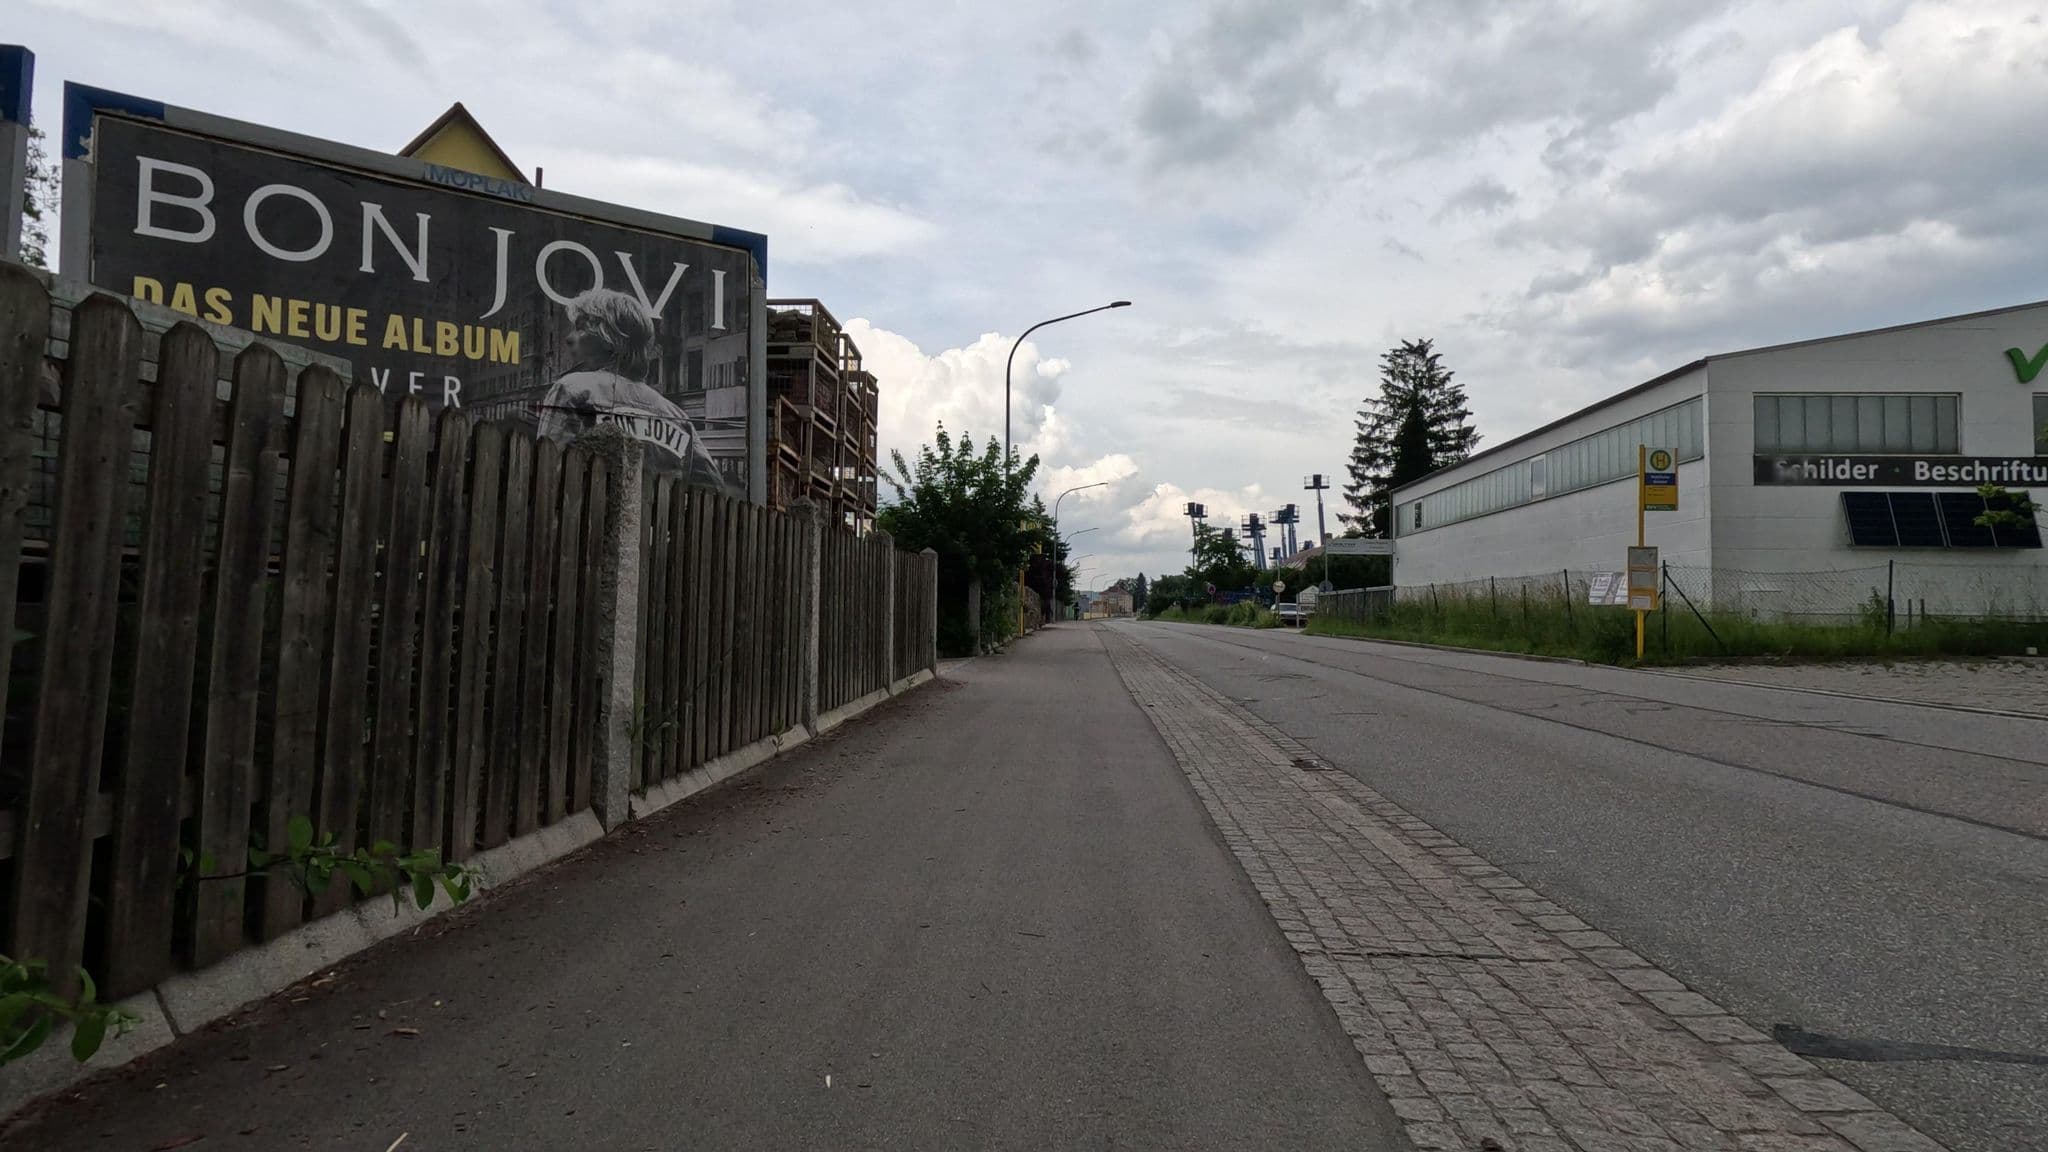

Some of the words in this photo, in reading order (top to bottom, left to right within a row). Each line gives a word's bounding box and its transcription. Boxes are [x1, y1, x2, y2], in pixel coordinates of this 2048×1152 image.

[133, 155, 431, 283] BON
[479, 226, 726, 330] JOVI
[133, 275, 233, 326] DAS
[251, 293, 368, 346] NEUE
[382, 313, 520, 364] ALBUM
[644, 416, 684, 452] JOVI
